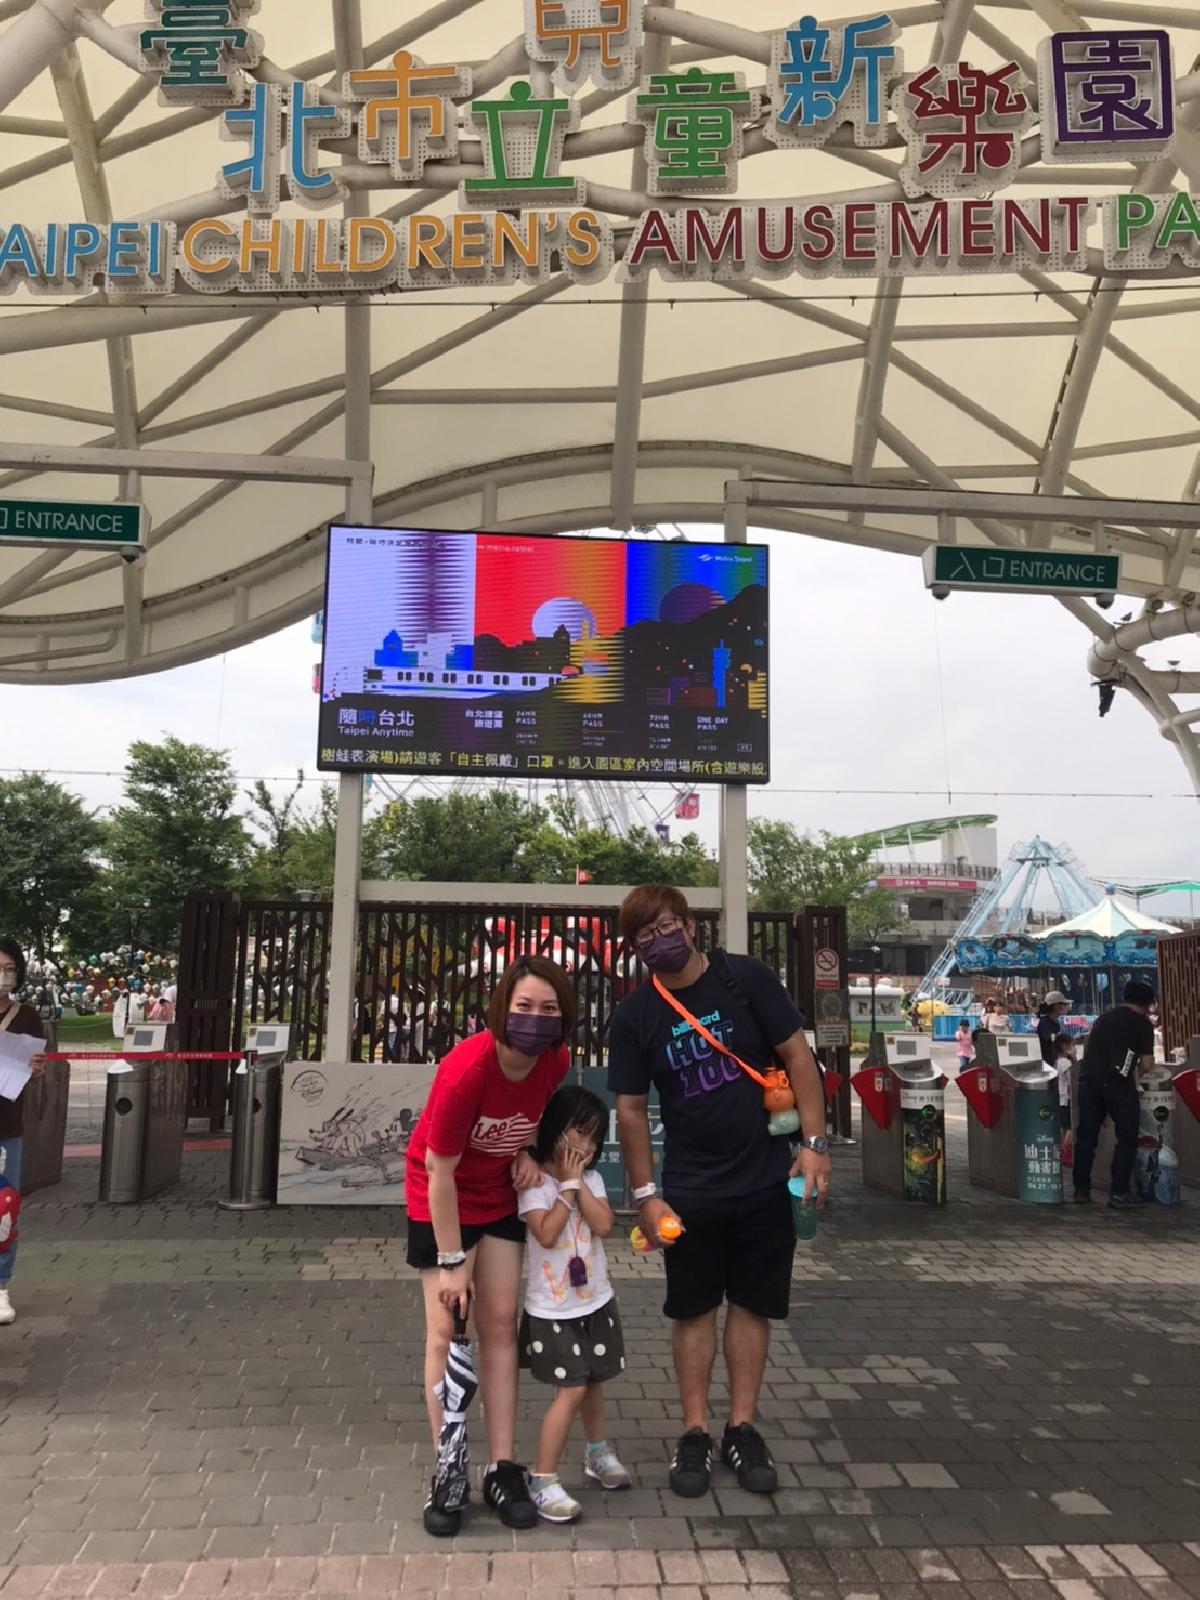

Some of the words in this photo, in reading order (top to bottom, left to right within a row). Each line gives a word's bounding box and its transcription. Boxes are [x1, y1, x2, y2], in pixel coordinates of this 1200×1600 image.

[182, 210, 599, 274] CHILDREN'S
[630, 196, 1088, 265] AMUSEMENT
[1116, 191, 1200, 250] PA
[15, 509, 123, 533] ENTRANCE
[950, 551, 1006, 580] 入口
[1010, 559, 1107, 583] ENTRANCE
[338, 725, 370, 736] Taipei
[372, 727, 415, 738] Anytime
[474, 1122, 507, 1140] Lee
